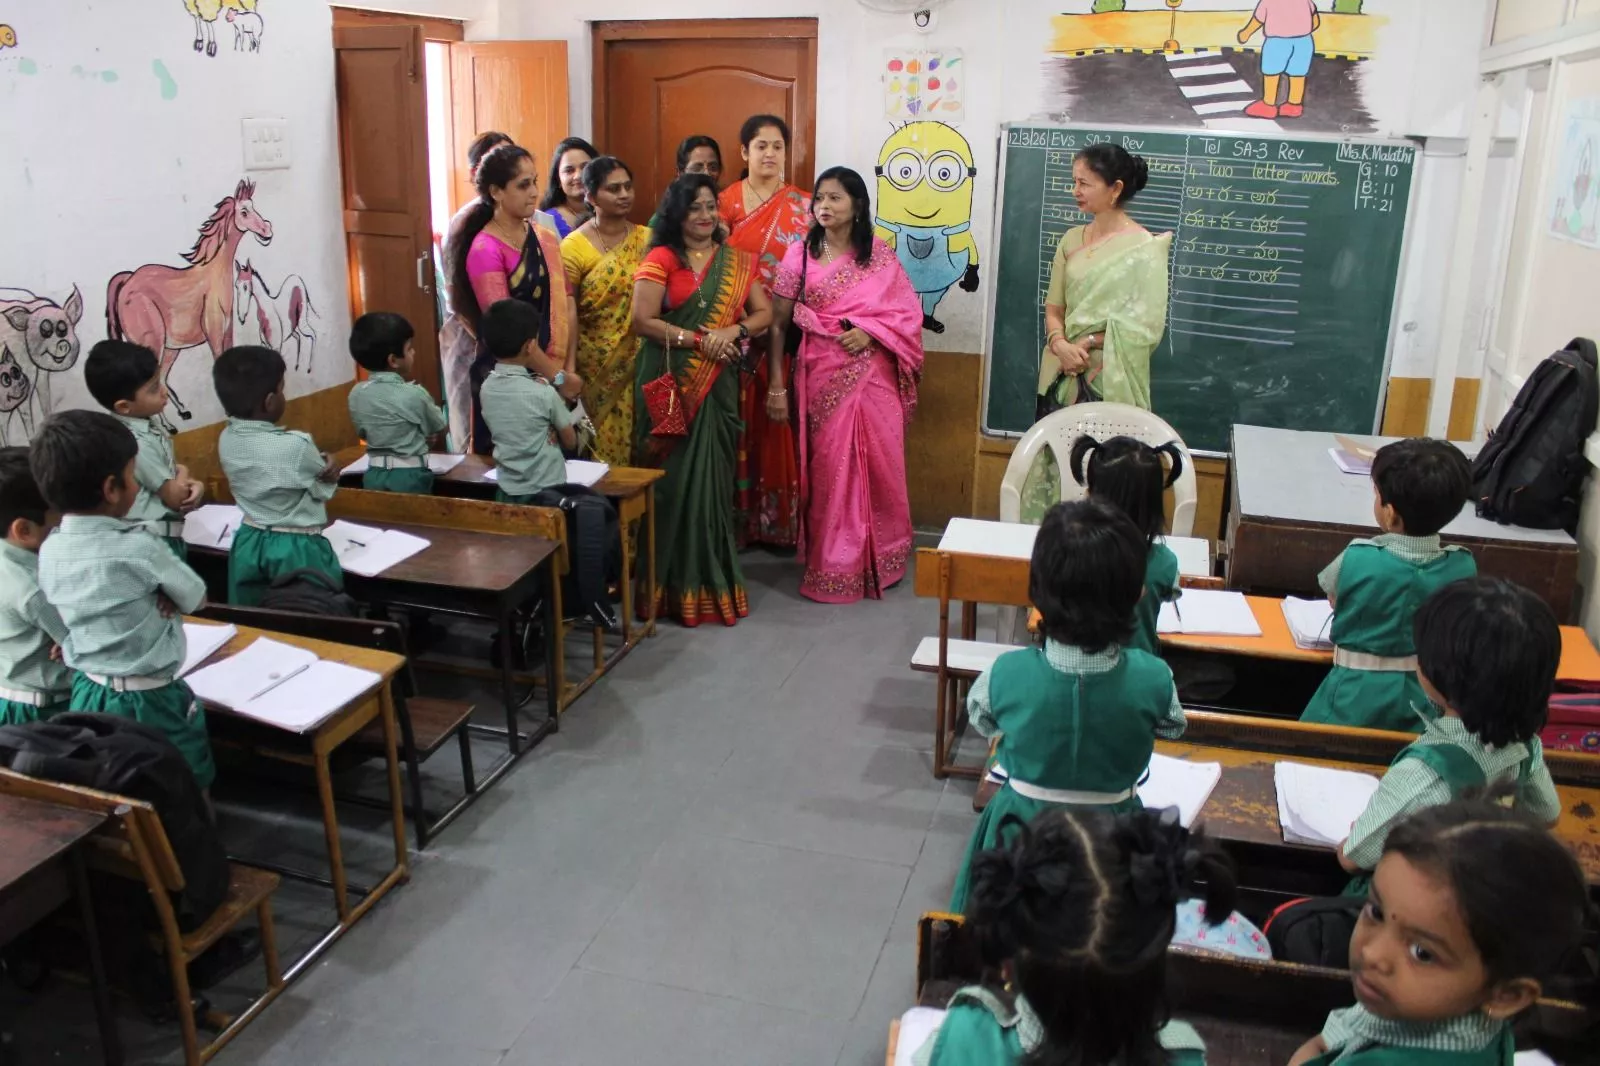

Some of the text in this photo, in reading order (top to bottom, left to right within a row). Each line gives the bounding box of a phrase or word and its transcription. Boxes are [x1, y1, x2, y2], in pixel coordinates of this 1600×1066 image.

[1121, 135, 1145, 150] Rev
[1200, 137, 1305, 160] Tel SA-3 Rev
[1206, 159, 1233, 178] Two
[1252, 162, 1291, 181] letter
